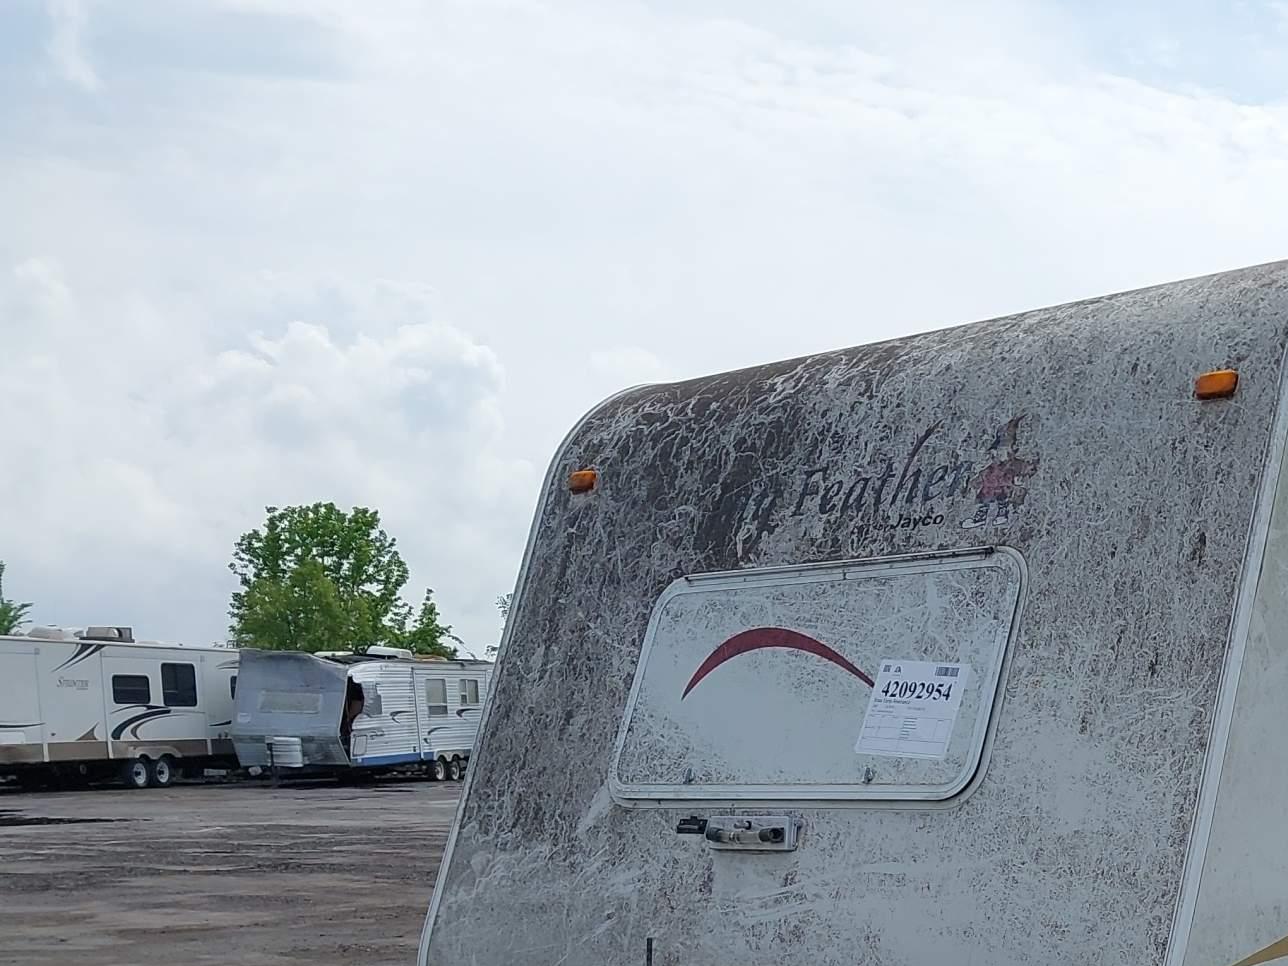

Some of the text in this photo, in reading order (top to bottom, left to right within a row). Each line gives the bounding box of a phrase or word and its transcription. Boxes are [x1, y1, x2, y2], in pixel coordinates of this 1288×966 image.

[790, 419, 974, 520] Feather
[893, 511, 945, 533] Jayco
[881, 679, 953, 702] 42092954
